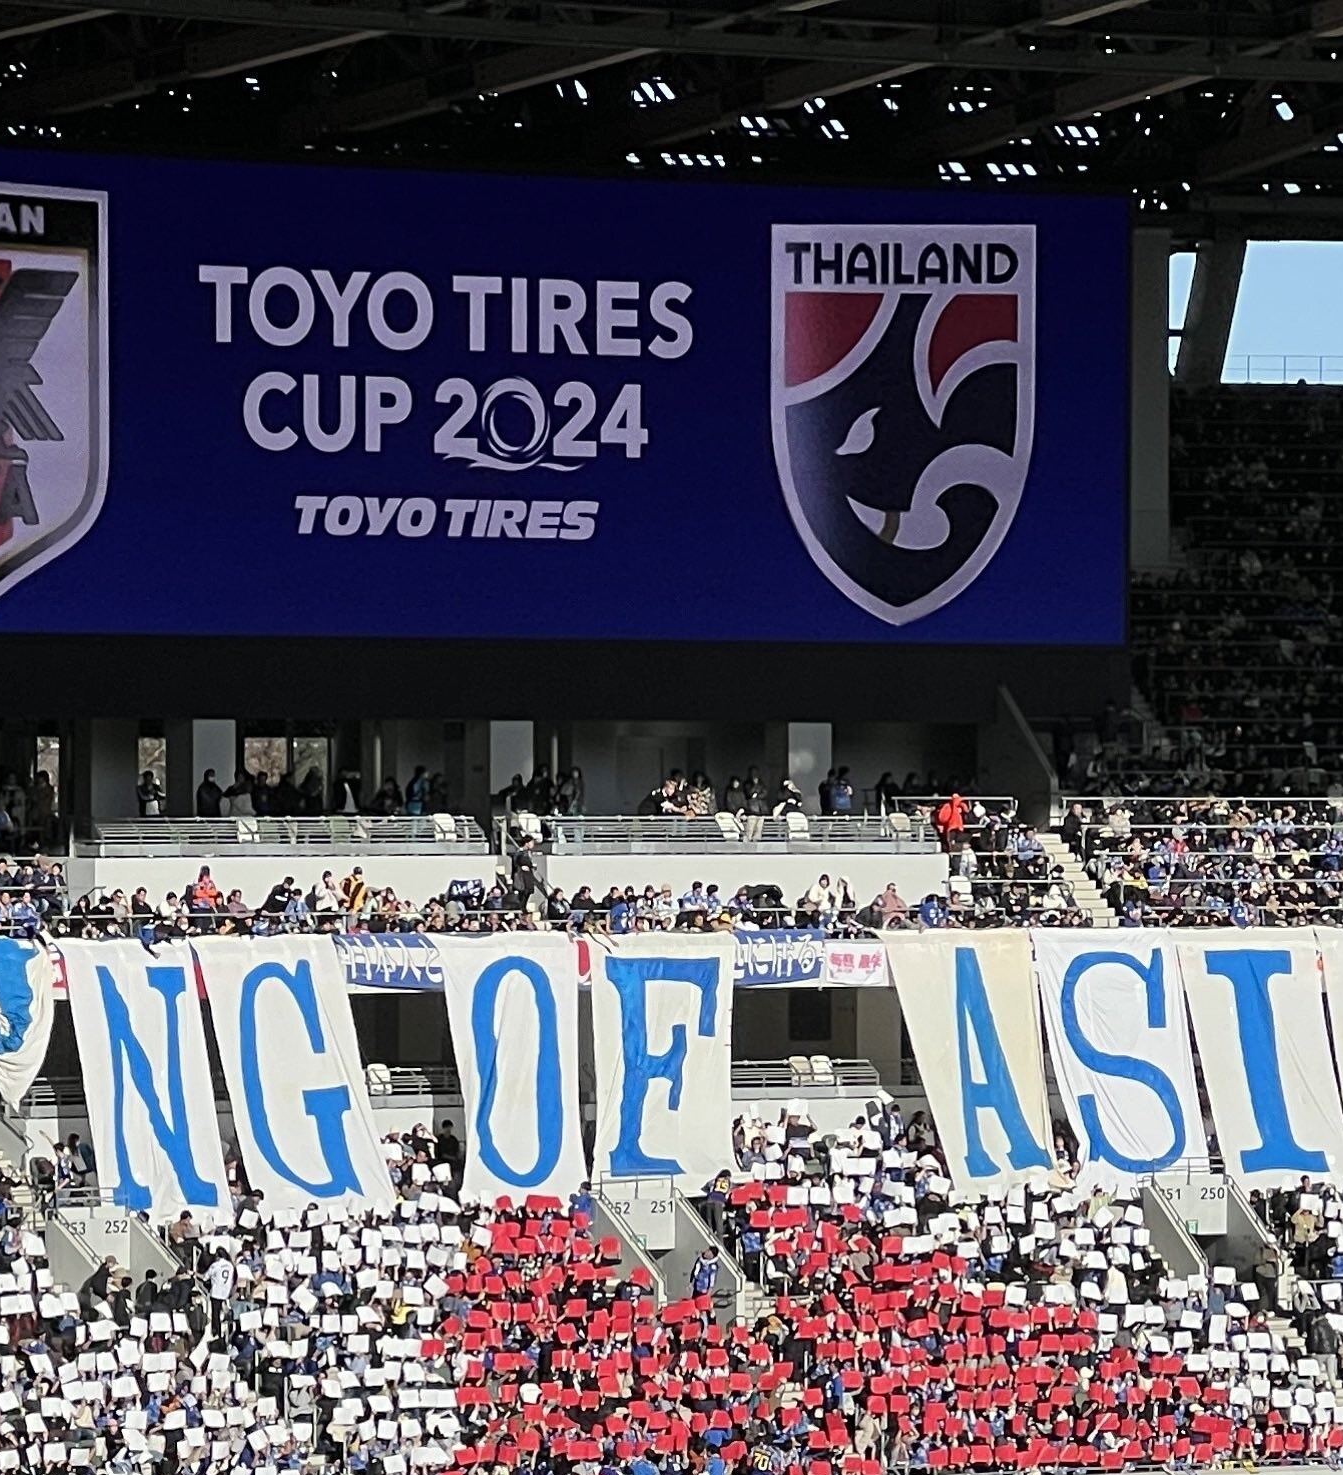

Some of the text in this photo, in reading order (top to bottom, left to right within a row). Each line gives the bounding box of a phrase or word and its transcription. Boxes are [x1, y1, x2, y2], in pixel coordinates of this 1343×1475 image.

[785, 240, 1019, 287] THAILAND
[199, 265, 693, 360] TOYO TIRES
[244, 371, 649, 470] CUP 2024
[295, 494, 600, 541] TOYO TIRES
[472, 955, 721, 1189] OF
[650, 1201, 674, 1214] 251
[1200, 1187, 1225, 1200] 250
[104, 1219, 129, 1234] 252
